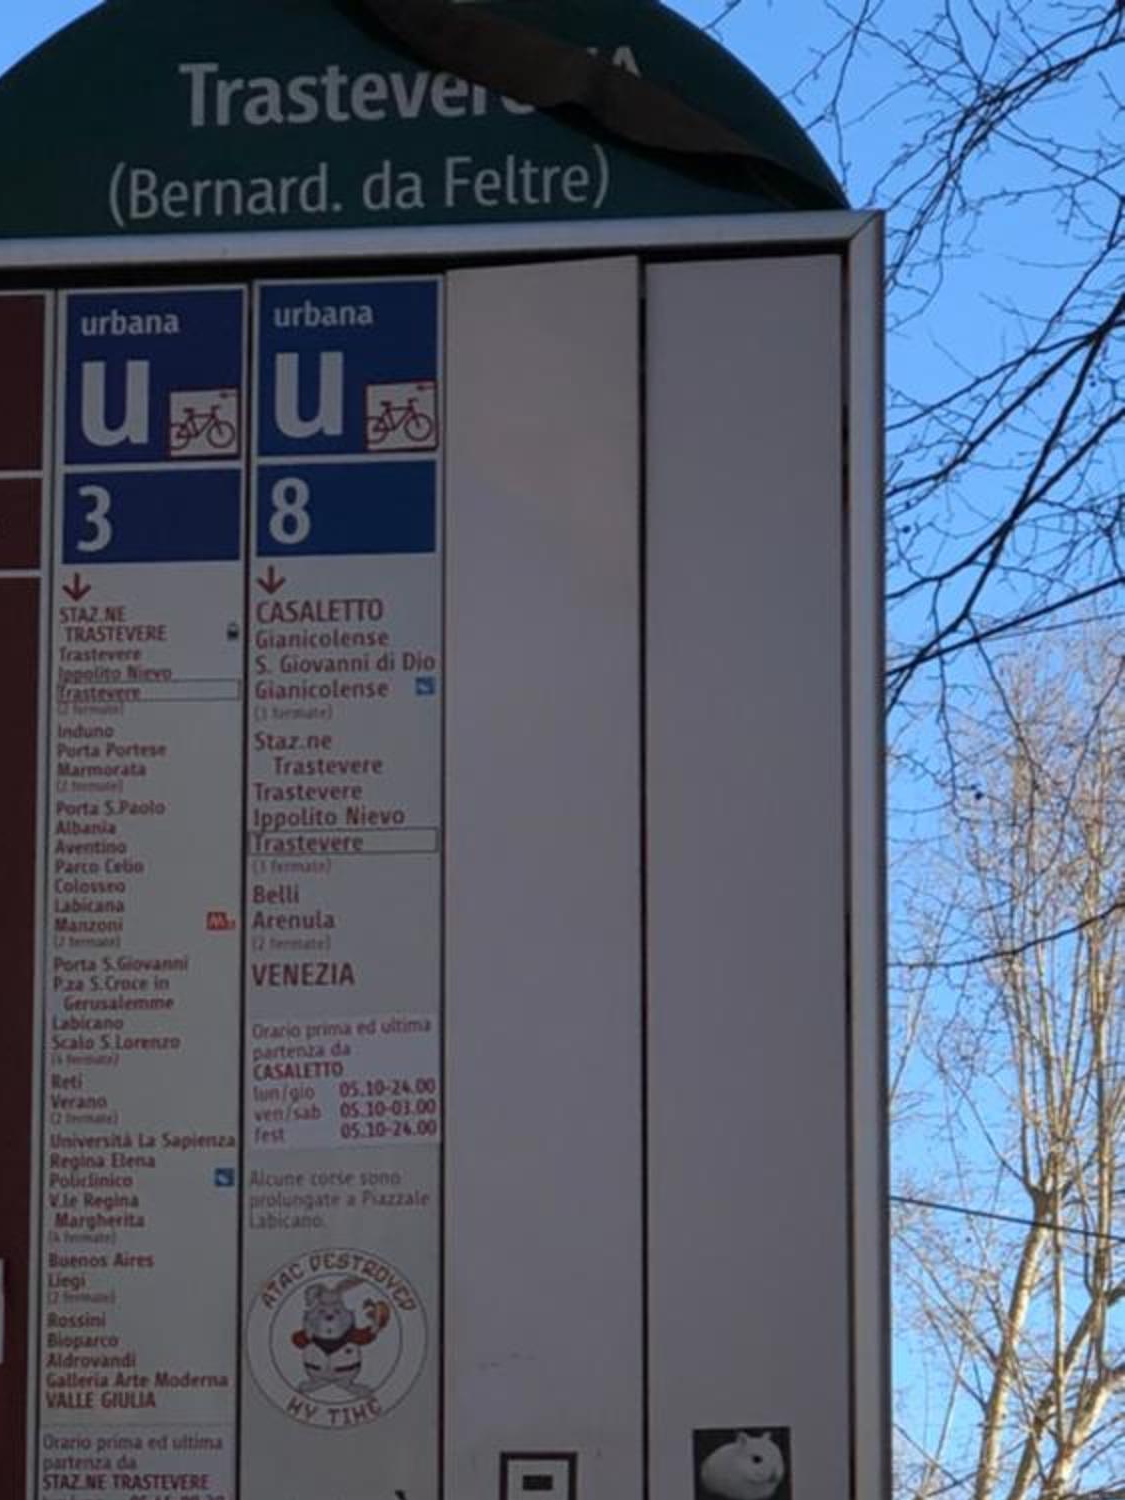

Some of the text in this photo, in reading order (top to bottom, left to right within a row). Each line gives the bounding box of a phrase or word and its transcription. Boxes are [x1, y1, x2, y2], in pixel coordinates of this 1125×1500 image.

[109, 143, 611, 227] (Bernard. da Feltre)
[274, 301, 373, 328] urbana
[82, 311, 180, 336] urbana
[77, 484, 113, 553] 3
[270, 478, 311, 544] 8
[256, 598, 384, 624] CASALETTO
[65, 625, 167, 642] TRASTEVERE
[255, 629, 389, 649] Gianicolense
[60, 648, 141, 661] Trastevere
[255, 652, 436, 675] S. Giovanni di Dio
[58, 686, 140, 700] Trastevere
[254, 679, 389, 700] Gianicolense
[58, 724, 114, 738] Induno
[255, 730, 332, 750] Staz.ne
[58, 743, 166, 757] Porta Portese
[57, 763, 146, 776] Marmorata
[274, 756, 383, 775] Trastevere
[252, 782, 364, 801] Trastevere
[56, 802, 98, 816] Porta
[254, 806, 405, 832] Ippolito Nievo
[56, 821, 116, 835] Albania
[56, 840, 126, 854] Aventino
[252, 833, 364, 852] Trastevere
[55, 860, 98, 873] Parco
[55, 880, 125, 893] Colosseo
[253, 884, 299, 904] Belli
[55, 899, 124, 913] Labicana
[55, 918, 123, 932] Manzoni
[252, 910, 335, 930] Arenula
[54, 957, 96, 972] Porta
[154, 976, 170, 990] in
[252, 962, 355, 987] VENEZIA
[63, 996, 174, 1011] Gerusalemme
[53, 1016, 123, 1030] Labicano
[252, 1017, 431, 1040] Orario prima ed ultima
[52, 1036, 94, 1049] Scalo
[252, 1043, 350, 1061] partenza da
[253, 1061, 343, 1081] CASALETTO
[51, 1074, 83, 1089] Reti
[339, 1078, 436, 1098] 05.10-24.00
[51, 1094, 108, 1109] Verano
[254, 1104, 322, 1121] ven/sab
[254, 1119, 437, 1143] fest 05.10-24.00
[138, 1133, 155, 1148] La
[163, 1133, 235, 1150] Sapienza
[50, 1154, 156, 1170] Regina Elena
[50, 1174, 133, 1188] Policlinico
[250, 1169, 401, 1186] Alcune corse sono
[85, 1194, 139, 1210] Regina
[250, 1191, 429, 1210] prolungate a Piazzale
[55, 1213, 145, 1230] Margherita
[49, 1253, 155, 1268] Buenos Aires
[48, 1274, 86, 1290] Liegi
[261, 1262, 305, 1309] ATAC
[47, 1313, 106, 1328] Rossini
[47, 1333, 119, 1349] Bioparco
[46, 1353, 136, 1368] Aldrovandi
[46, 1372, 228, 1388] Galleria Arte Moderna
[46, 1392, 155, 1408] VALLE GIULIA
[44, 1433, 222, 1452] Orario prima ed ultima
[43, 1455, 137, 1472] partenza da
[112, 1474, 209, 1490] TRASTEVERE
